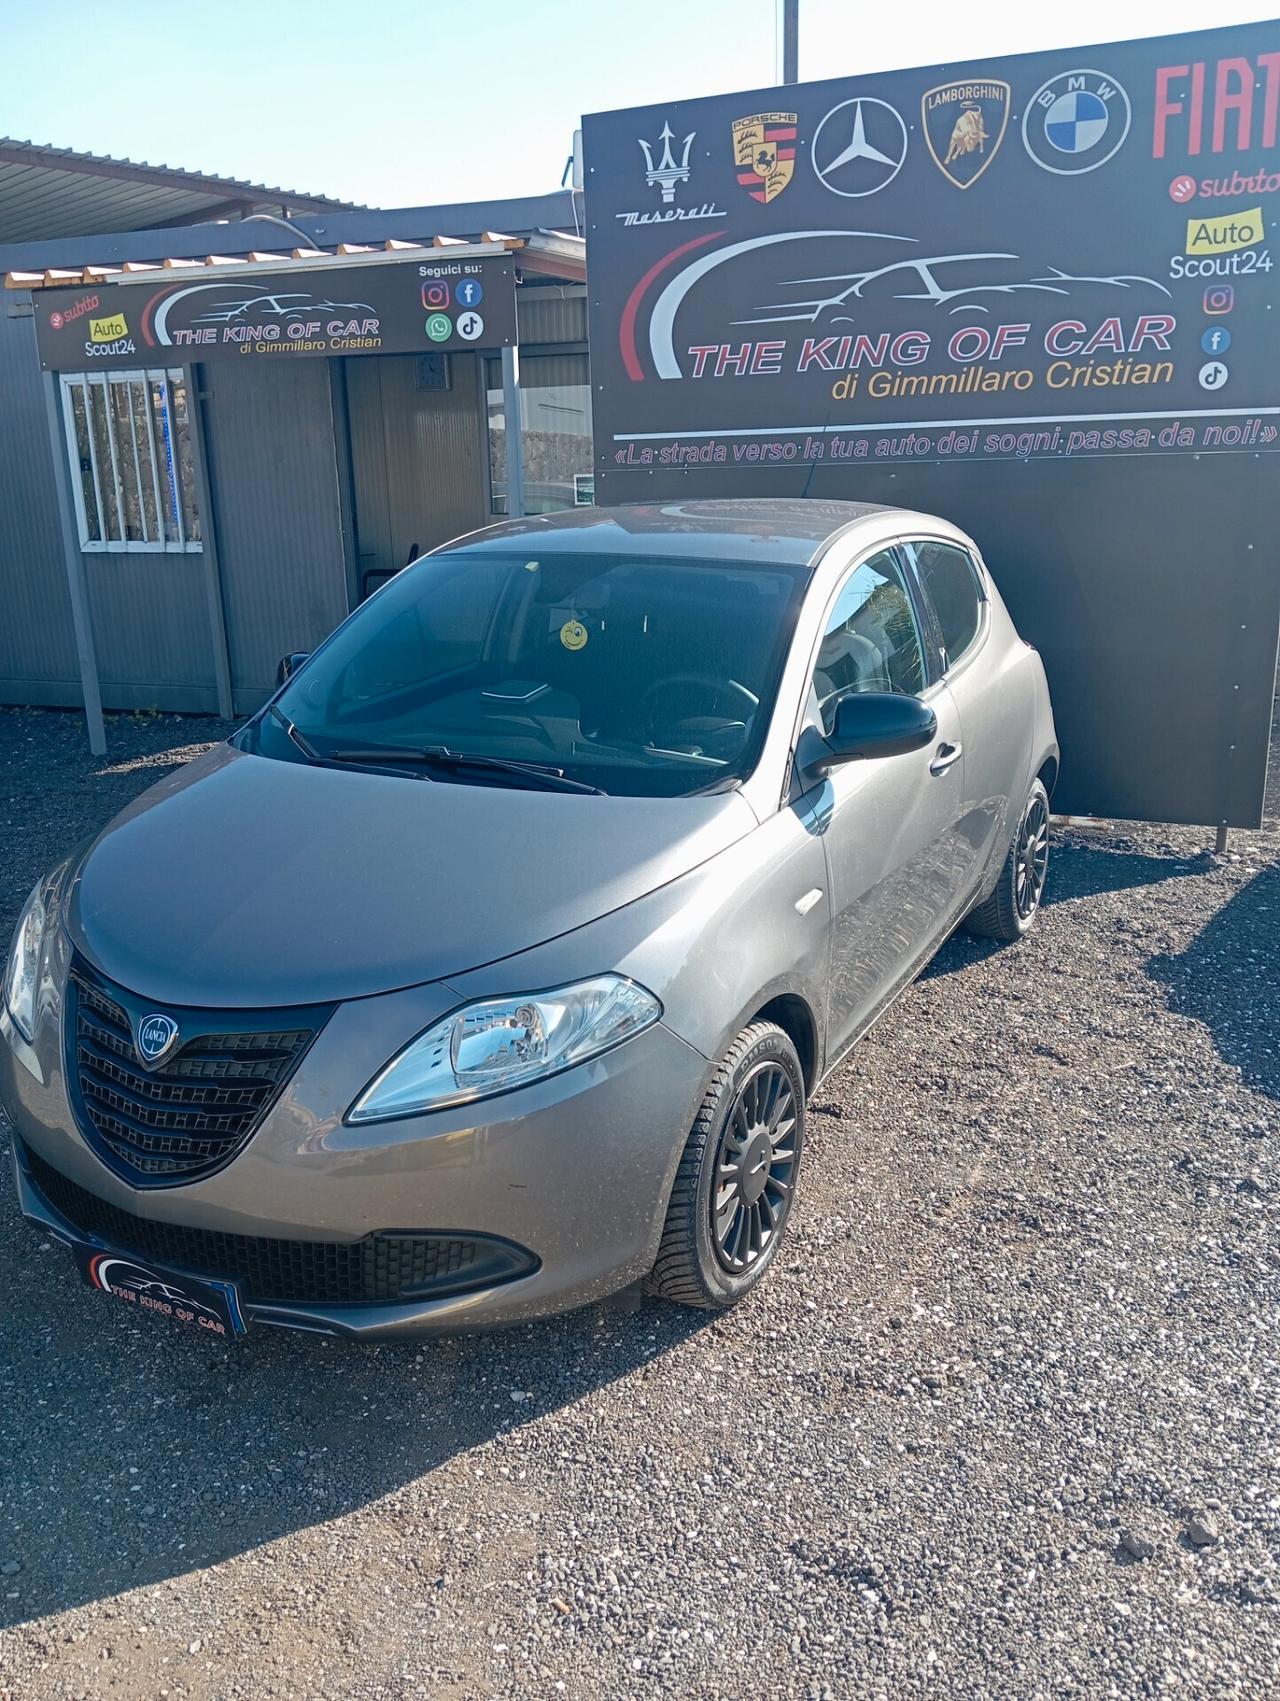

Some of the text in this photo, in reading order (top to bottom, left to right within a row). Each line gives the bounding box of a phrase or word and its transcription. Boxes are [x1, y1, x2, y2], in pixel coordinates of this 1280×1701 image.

[928, 85, 1004, 110] LAMBORGHINI
[1038, 76, 1116, 108] BMW
[1153, 51, 1280, 158] FIAT
[733, 112, 796, 130] PORSCHE
[1198, 168, 1280, 197] subito
[615, 203, 727, 226] Maserati
[1192, 223, 1254, 246] Auto
[418, 264, 483, 278] Seguici su:
[1169, 250, 1273, 278] Scout24
[64, 295, 100, 322] subito
[93, 321, 123, 337] Auto
[173, 318, 380, 345] THE KING OF CAR
[85, 340, 136, 357] Scout24
[240, 335, 382, 354] di Gimmillaro Cristian
[688, 314, 1176, 378] THE KING OF CAR
[832, 357, 1174, 400] di Gimmillaro Cristian
[659, 441, 727, 464] strada
[733, 443, 798, 462] verso
[803, 436, 825, 459] la
[830, 437, 869, 458] tua
[875, 433, 931, 456] auto
[937, 430, 980, 454] dei
[984, 426, 1062, 457] sogni
[1065, 427, 1152, 455] passa
[1158, 422, 1196, 447] da
[144, 1028, 166, 1043] LANCIA
[110, 1284, 225, 1335] THE KING OF CAR
